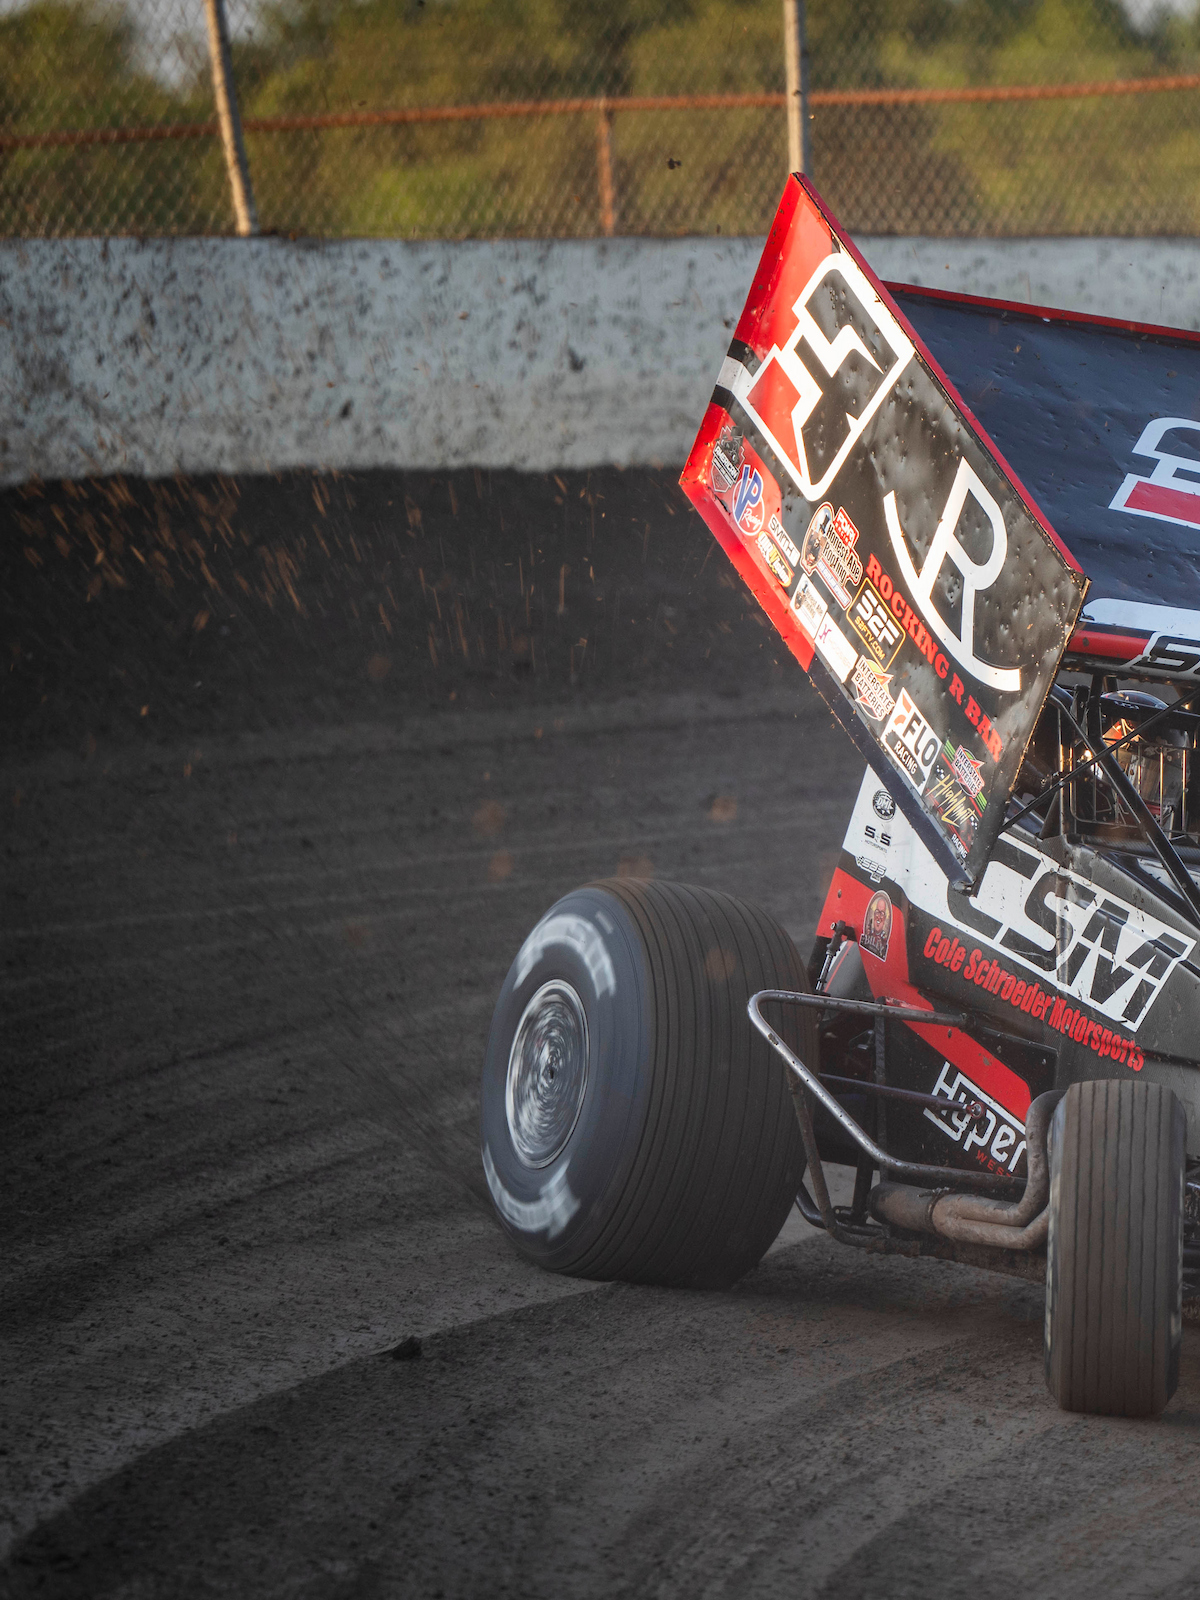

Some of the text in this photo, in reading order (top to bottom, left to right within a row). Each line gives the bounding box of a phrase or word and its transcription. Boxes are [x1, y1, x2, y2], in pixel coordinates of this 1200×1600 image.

[734, 465, 763, 523] VP
[741, 507, 762, 531] Racing
[826, 524, 861, 580] Honest Abe
[855, 616, 886, 660] S2FTV.COM
[856, 589, 900, 646] S2F
[866, 553, 1003, 763] ROCKING R BAR
[855, 672, 885, 718] BATTERIES
[858, 659, 893, 710] INTERSTATE
[893, 741, 918, 775] RACING
[902, 711, 938, 767] FLO
[954, 758, 979, 795] BATTERIES
[957, 748, 982, 790] INTERSTATE
[951, 833, 968, 859] RACING
[923, 926, 1145, 1072] Cole Schroeder Motorsports
[975, 1149, 1012, 1178] WES
